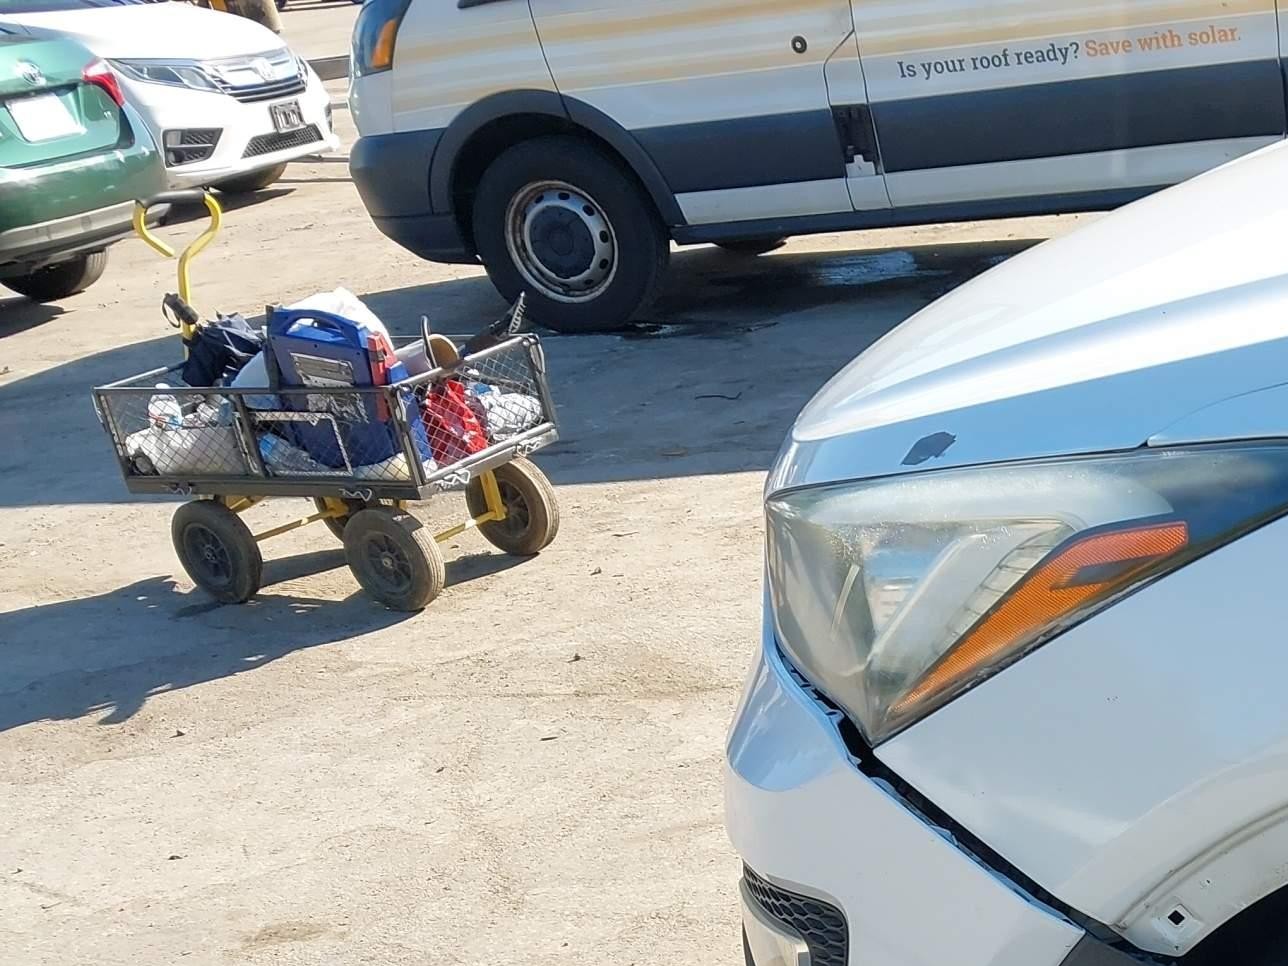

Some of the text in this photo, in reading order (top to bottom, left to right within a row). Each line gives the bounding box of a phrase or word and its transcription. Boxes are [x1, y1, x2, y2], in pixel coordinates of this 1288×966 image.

[897, 25, 1242, 80] Is your roof ready? Save with solar.
